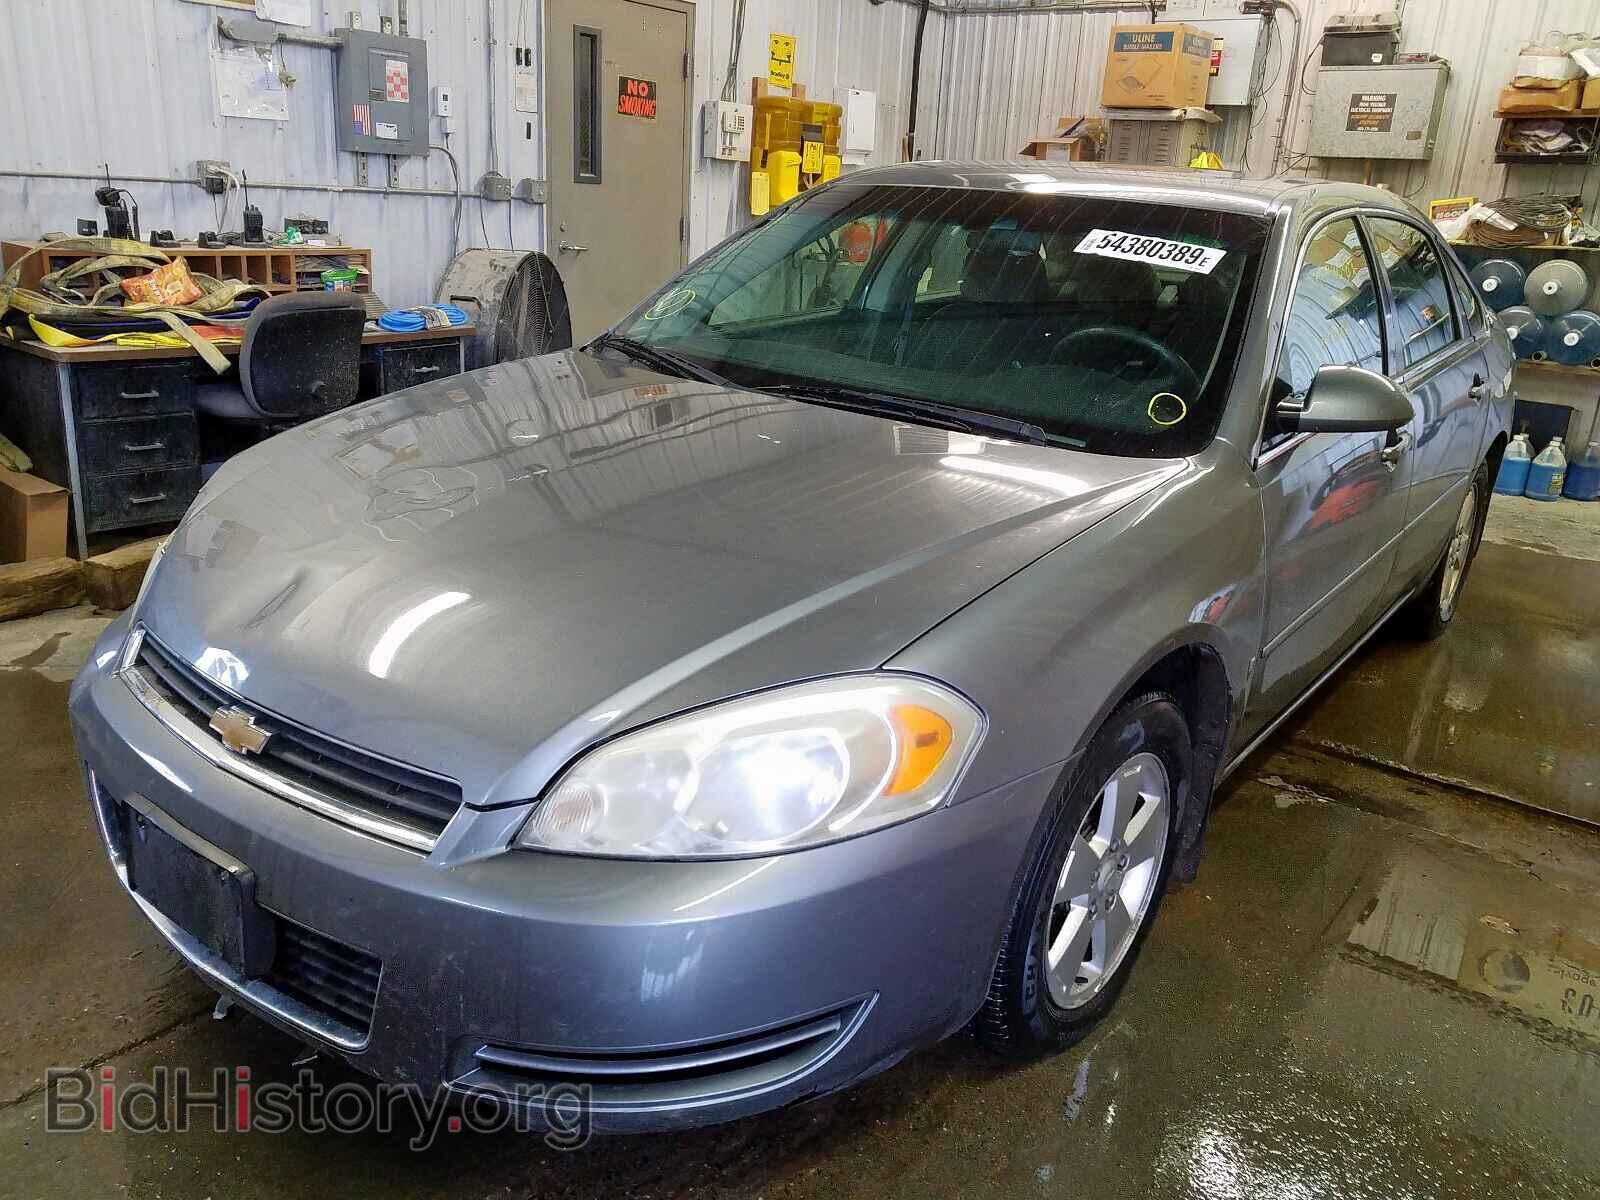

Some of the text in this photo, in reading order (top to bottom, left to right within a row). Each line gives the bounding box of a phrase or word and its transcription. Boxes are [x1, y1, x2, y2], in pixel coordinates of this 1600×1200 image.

[1132, 34, 1156, 43] ULINE
[628, 80, 648, 96] NO
[619, 95, 656, 117] SMOKING
